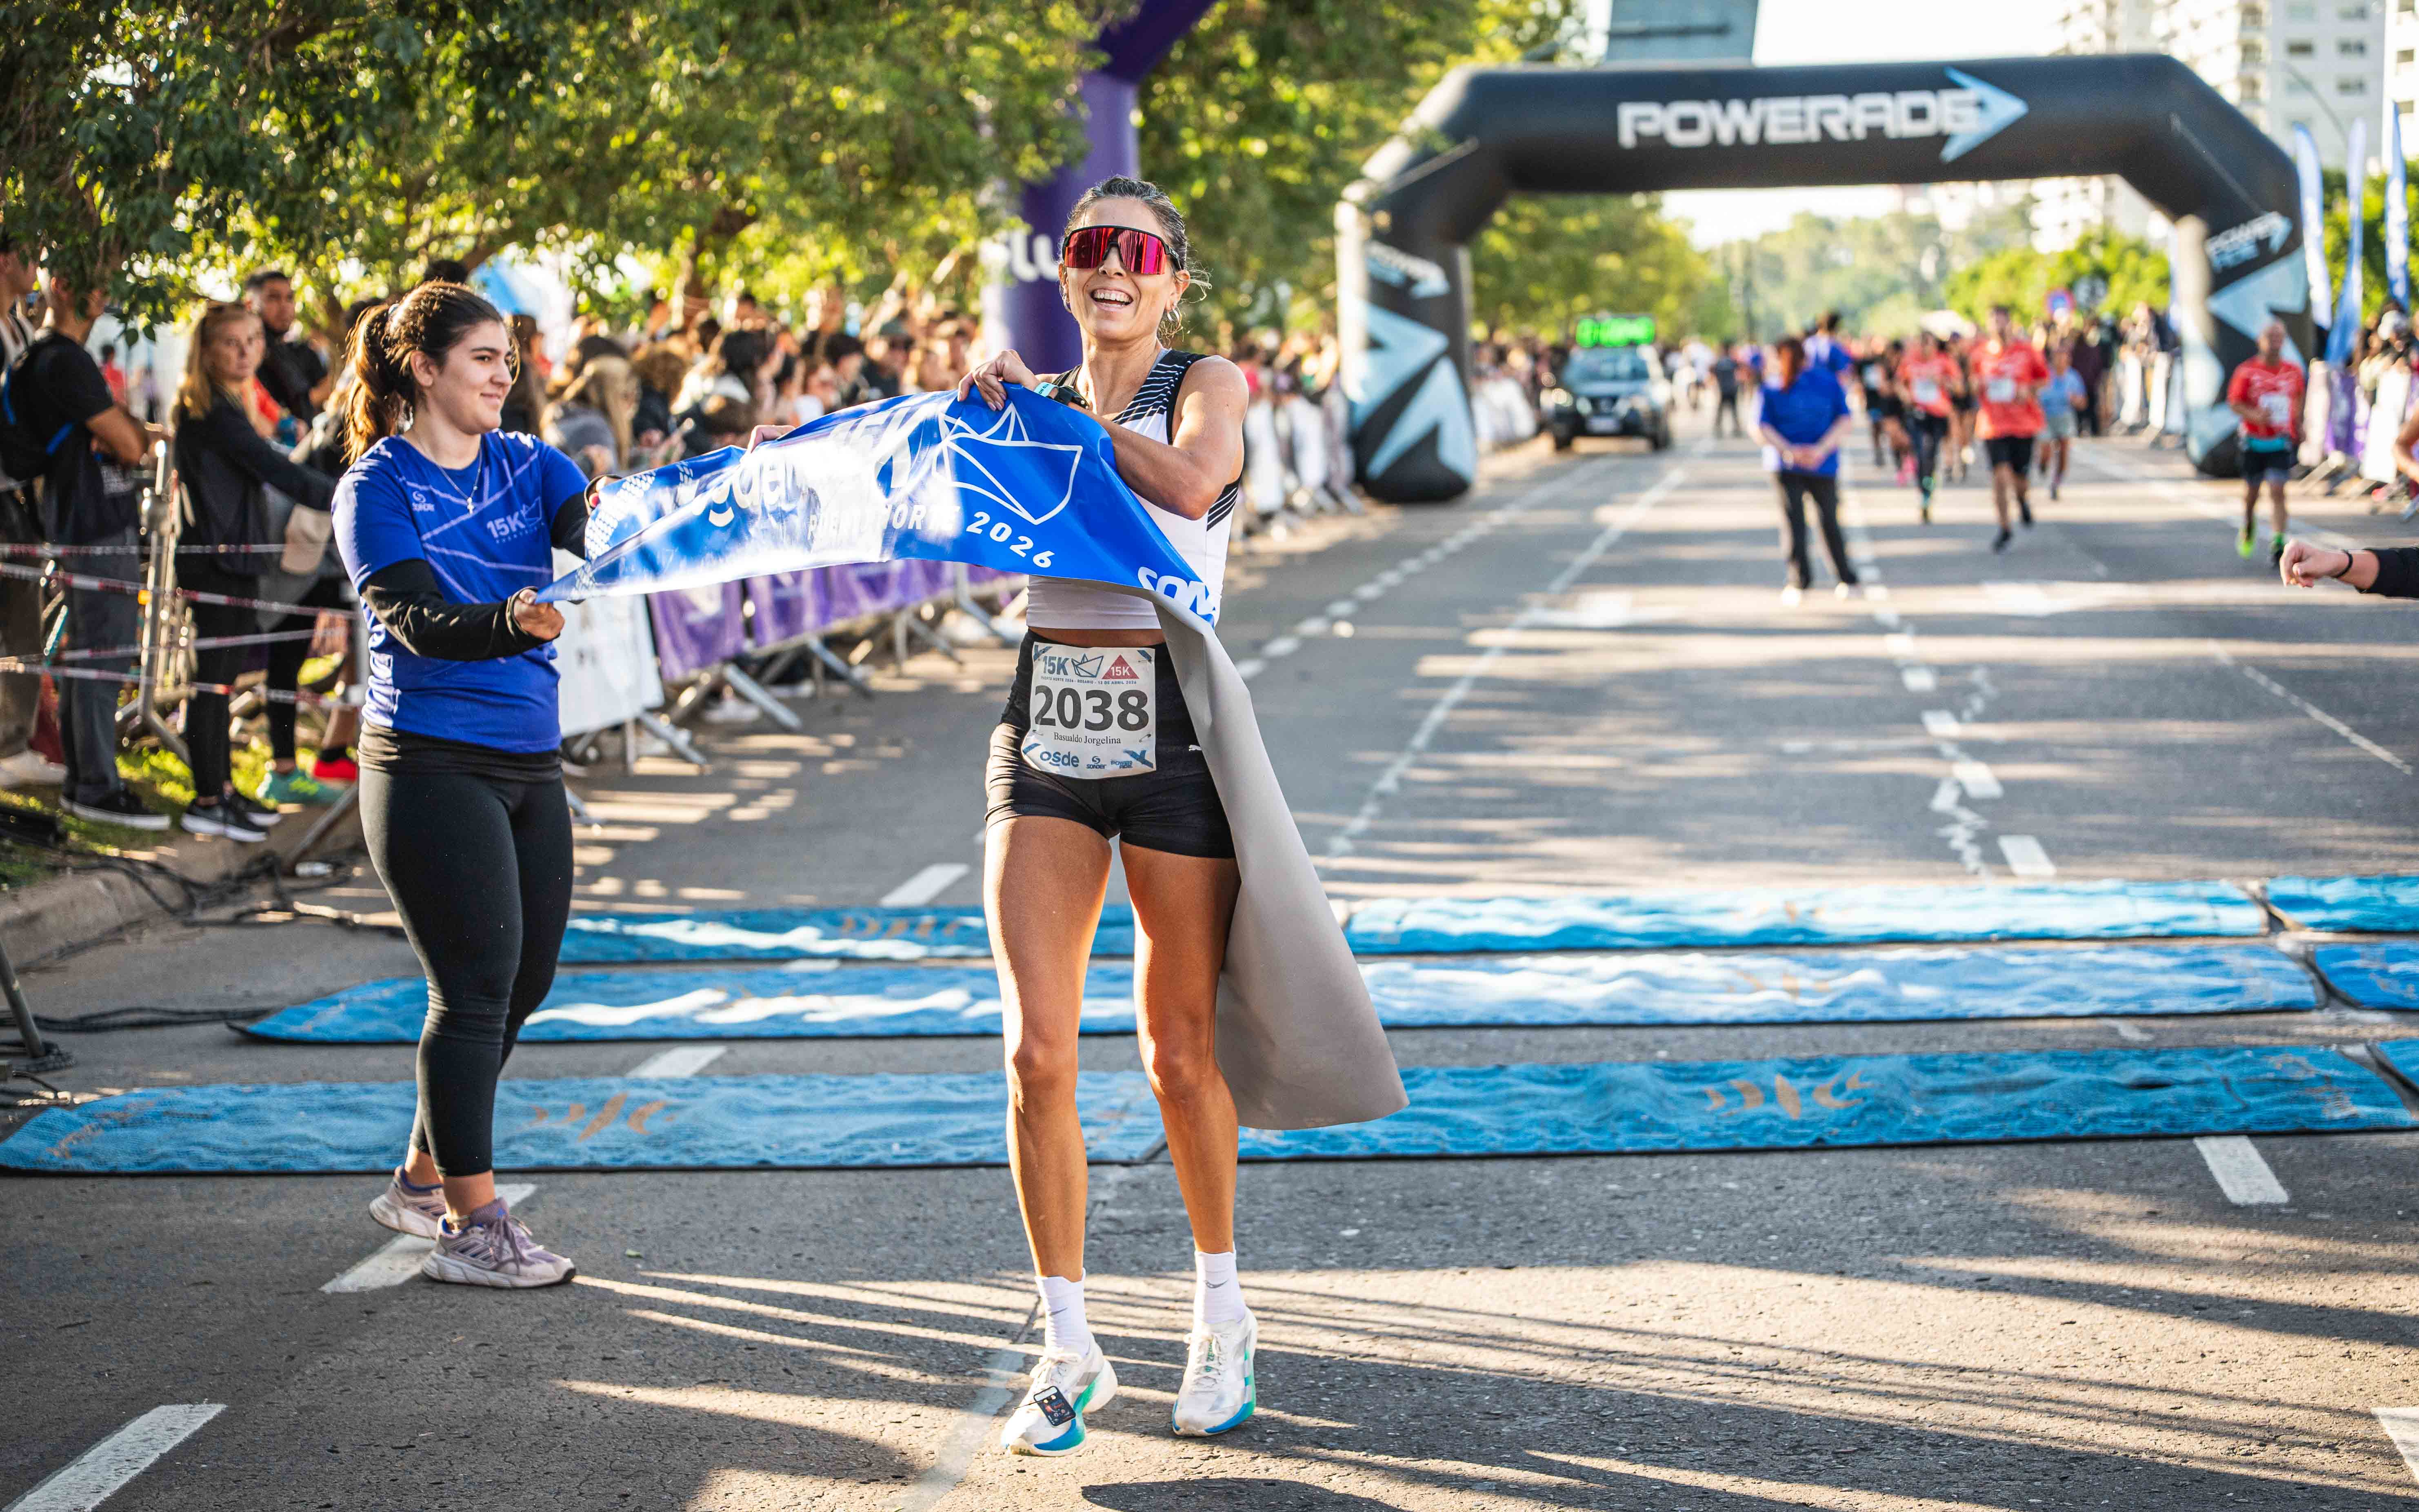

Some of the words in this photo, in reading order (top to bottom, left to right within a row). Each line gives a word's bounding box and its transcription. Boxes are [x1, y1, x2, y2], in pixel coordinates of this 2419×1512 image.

[1617, 88, 1981, 148] POWERADE
[486, 511, 526, 538] 15K
[966, 511, 1055, 568] 2026
[1043, 656, 1070, 675] 15K
[1111, 666, 1130, 676] 15K
[1035, 685, 1149, 731] 2038
[1054, 732, 1082, 743] Basualdo
[1084, 736, 1121, 746] Jorgelina
[1040, 751, 1080, 767] osde
